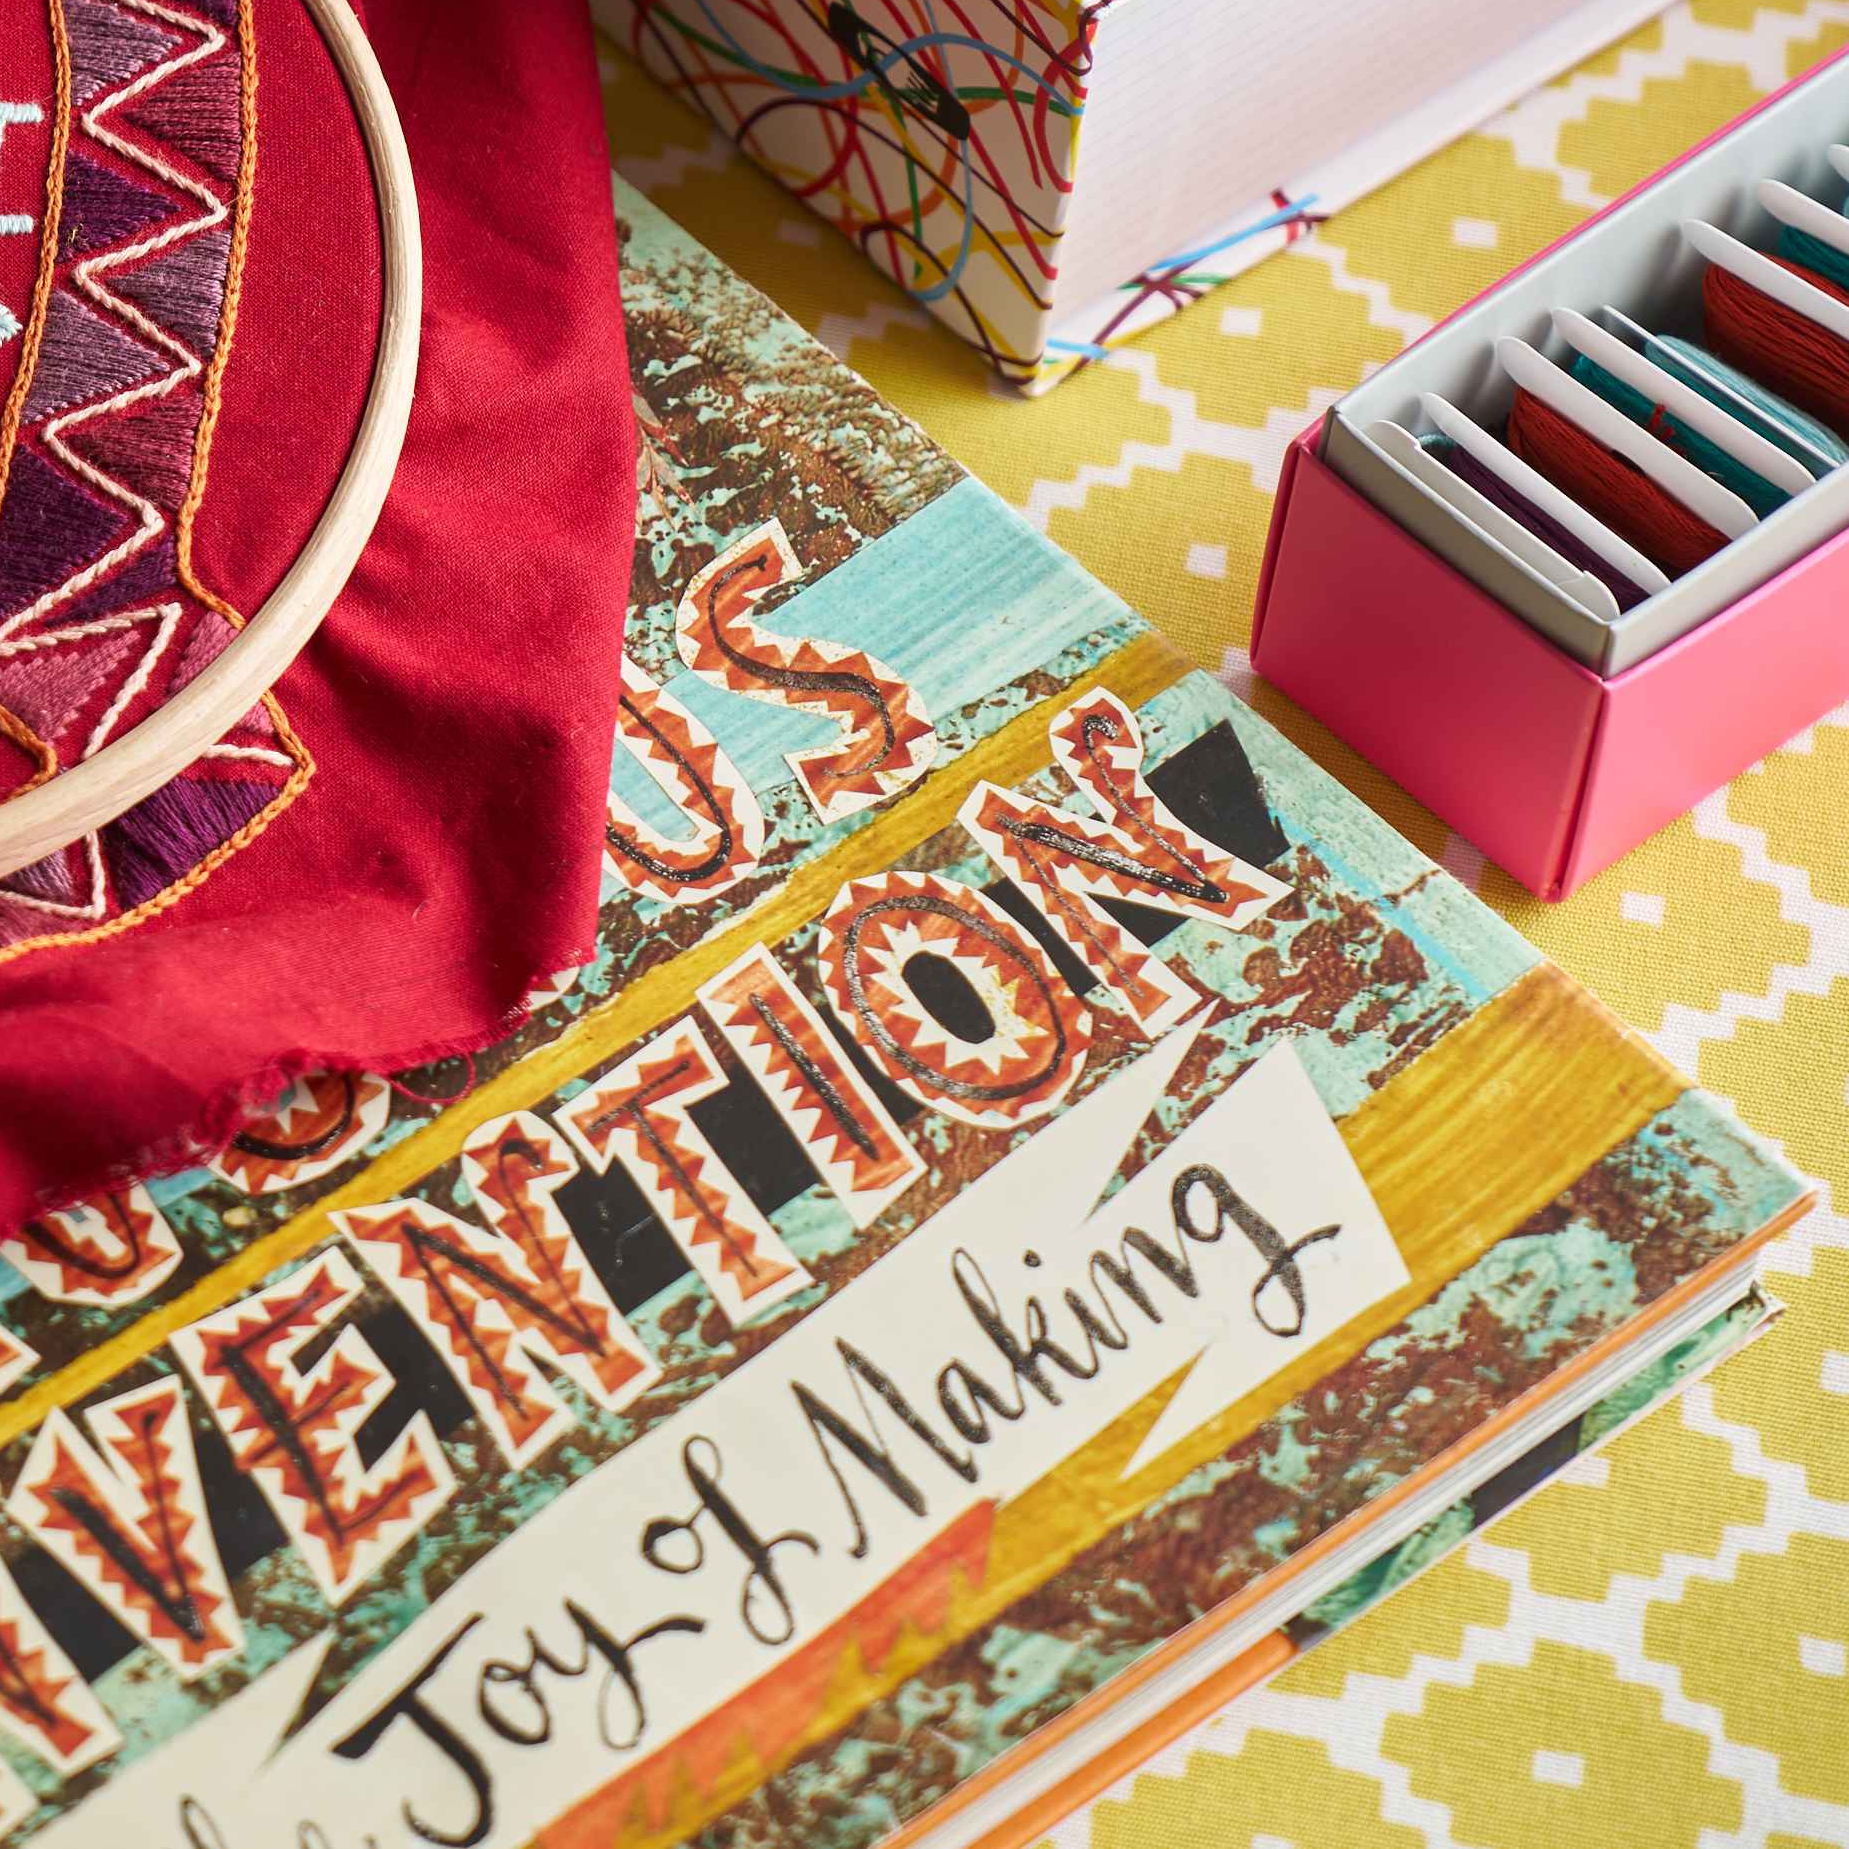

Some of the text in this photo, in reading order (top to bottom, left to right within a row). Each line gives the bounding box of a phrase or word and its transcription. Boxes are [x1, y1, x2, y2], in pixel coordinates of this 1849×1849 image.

[332, 1161, 1342, 1849] Joy of Making
